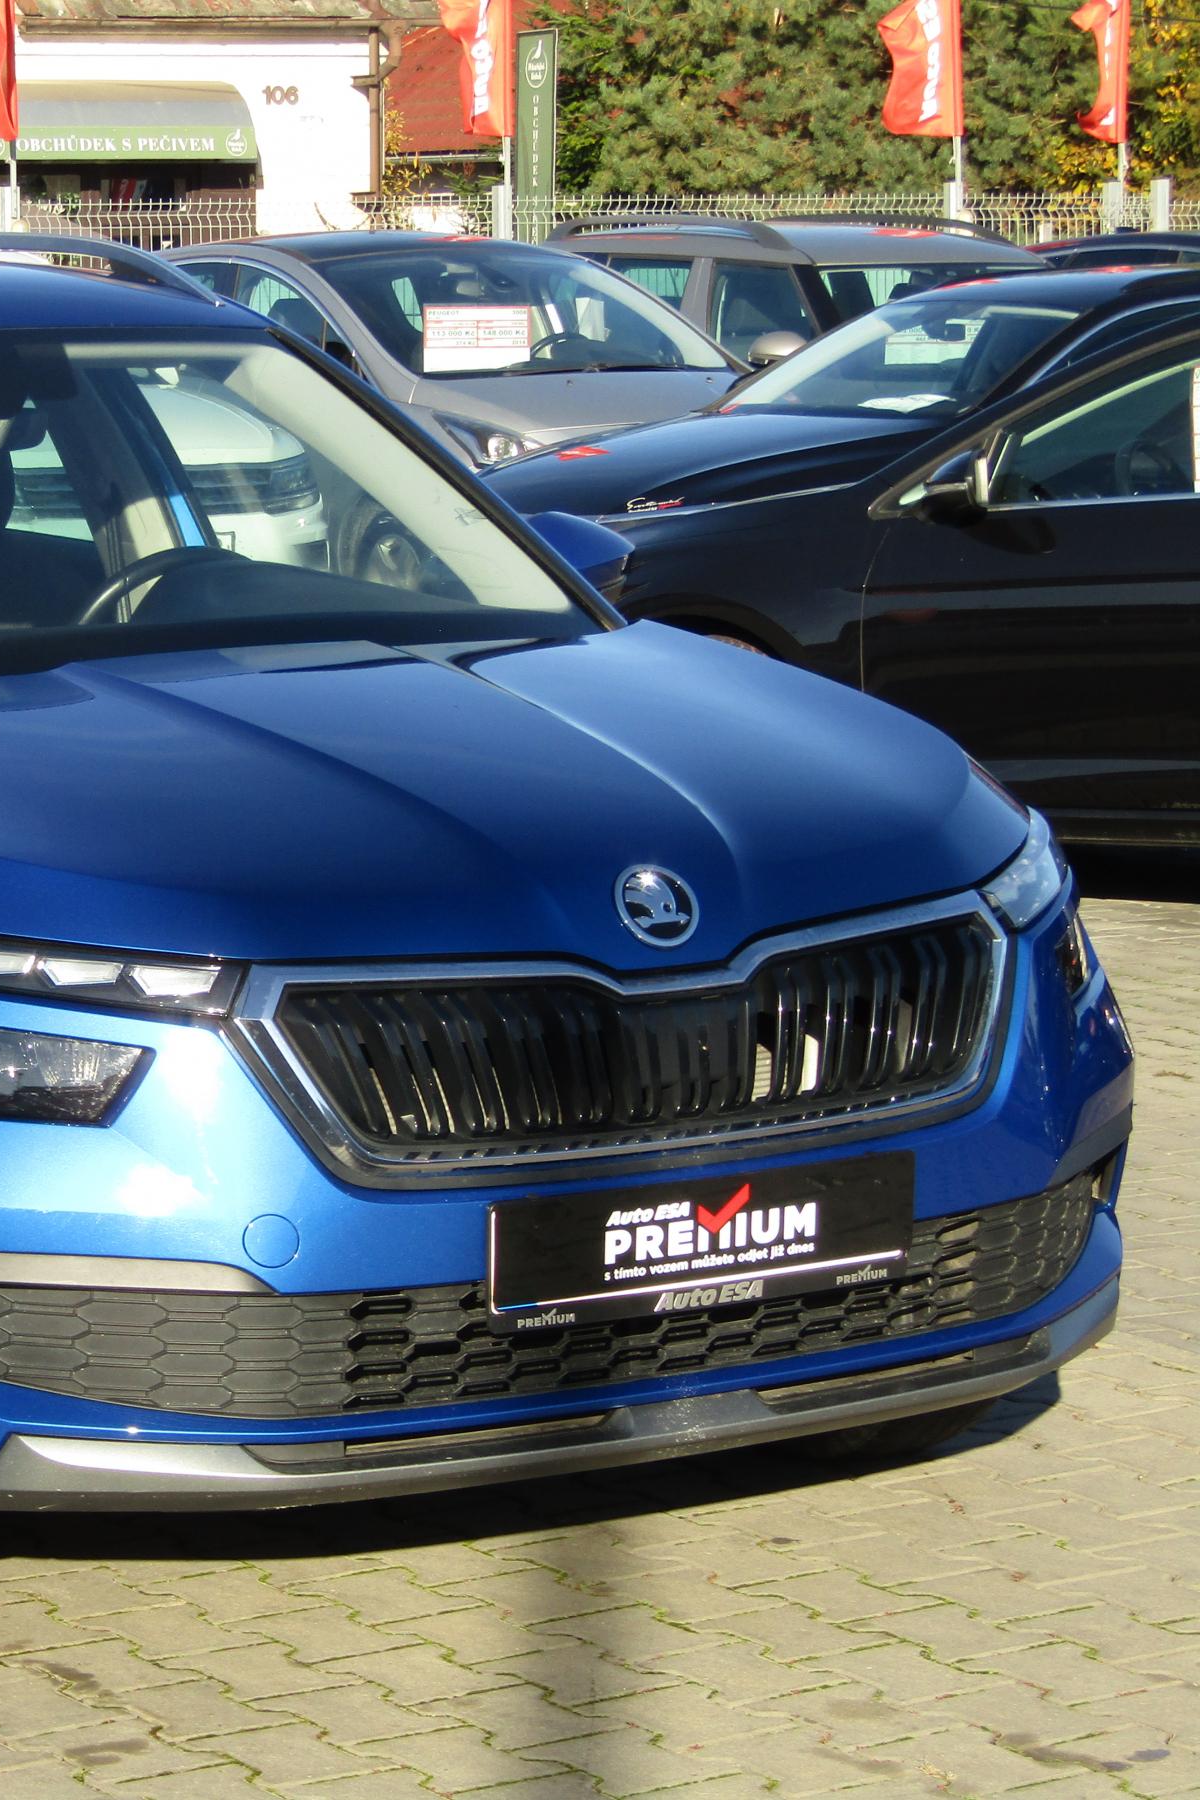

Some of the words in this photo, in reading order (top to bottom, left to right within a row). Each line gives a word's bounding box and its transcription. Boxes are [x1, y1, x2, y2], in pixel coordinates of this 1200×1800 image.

[262, 85, 299, 105] 106
[15, 134, 117, 151] OBCHŮDEK
[122, 137, 132, 151] S
[138, 135, 215, 151] PEČIVEM
[604, 1201, 817, 1265] PREMIUM
[604, 1272, 611, 1281] s
[614, 1266, 647, 1280] tímto
[650, 1260, 689, 1275] vozem
[691, 1253, 735, 1271] můžete
[737, 1248, 768, 1263] odjet
[770, 1245, 784, 1260] již
[787, 1242, 815, 1256] dnes
[836, 1268, 888, 1286] PREMIUM
[517, 1311, 576, 1329] PREMIUM
